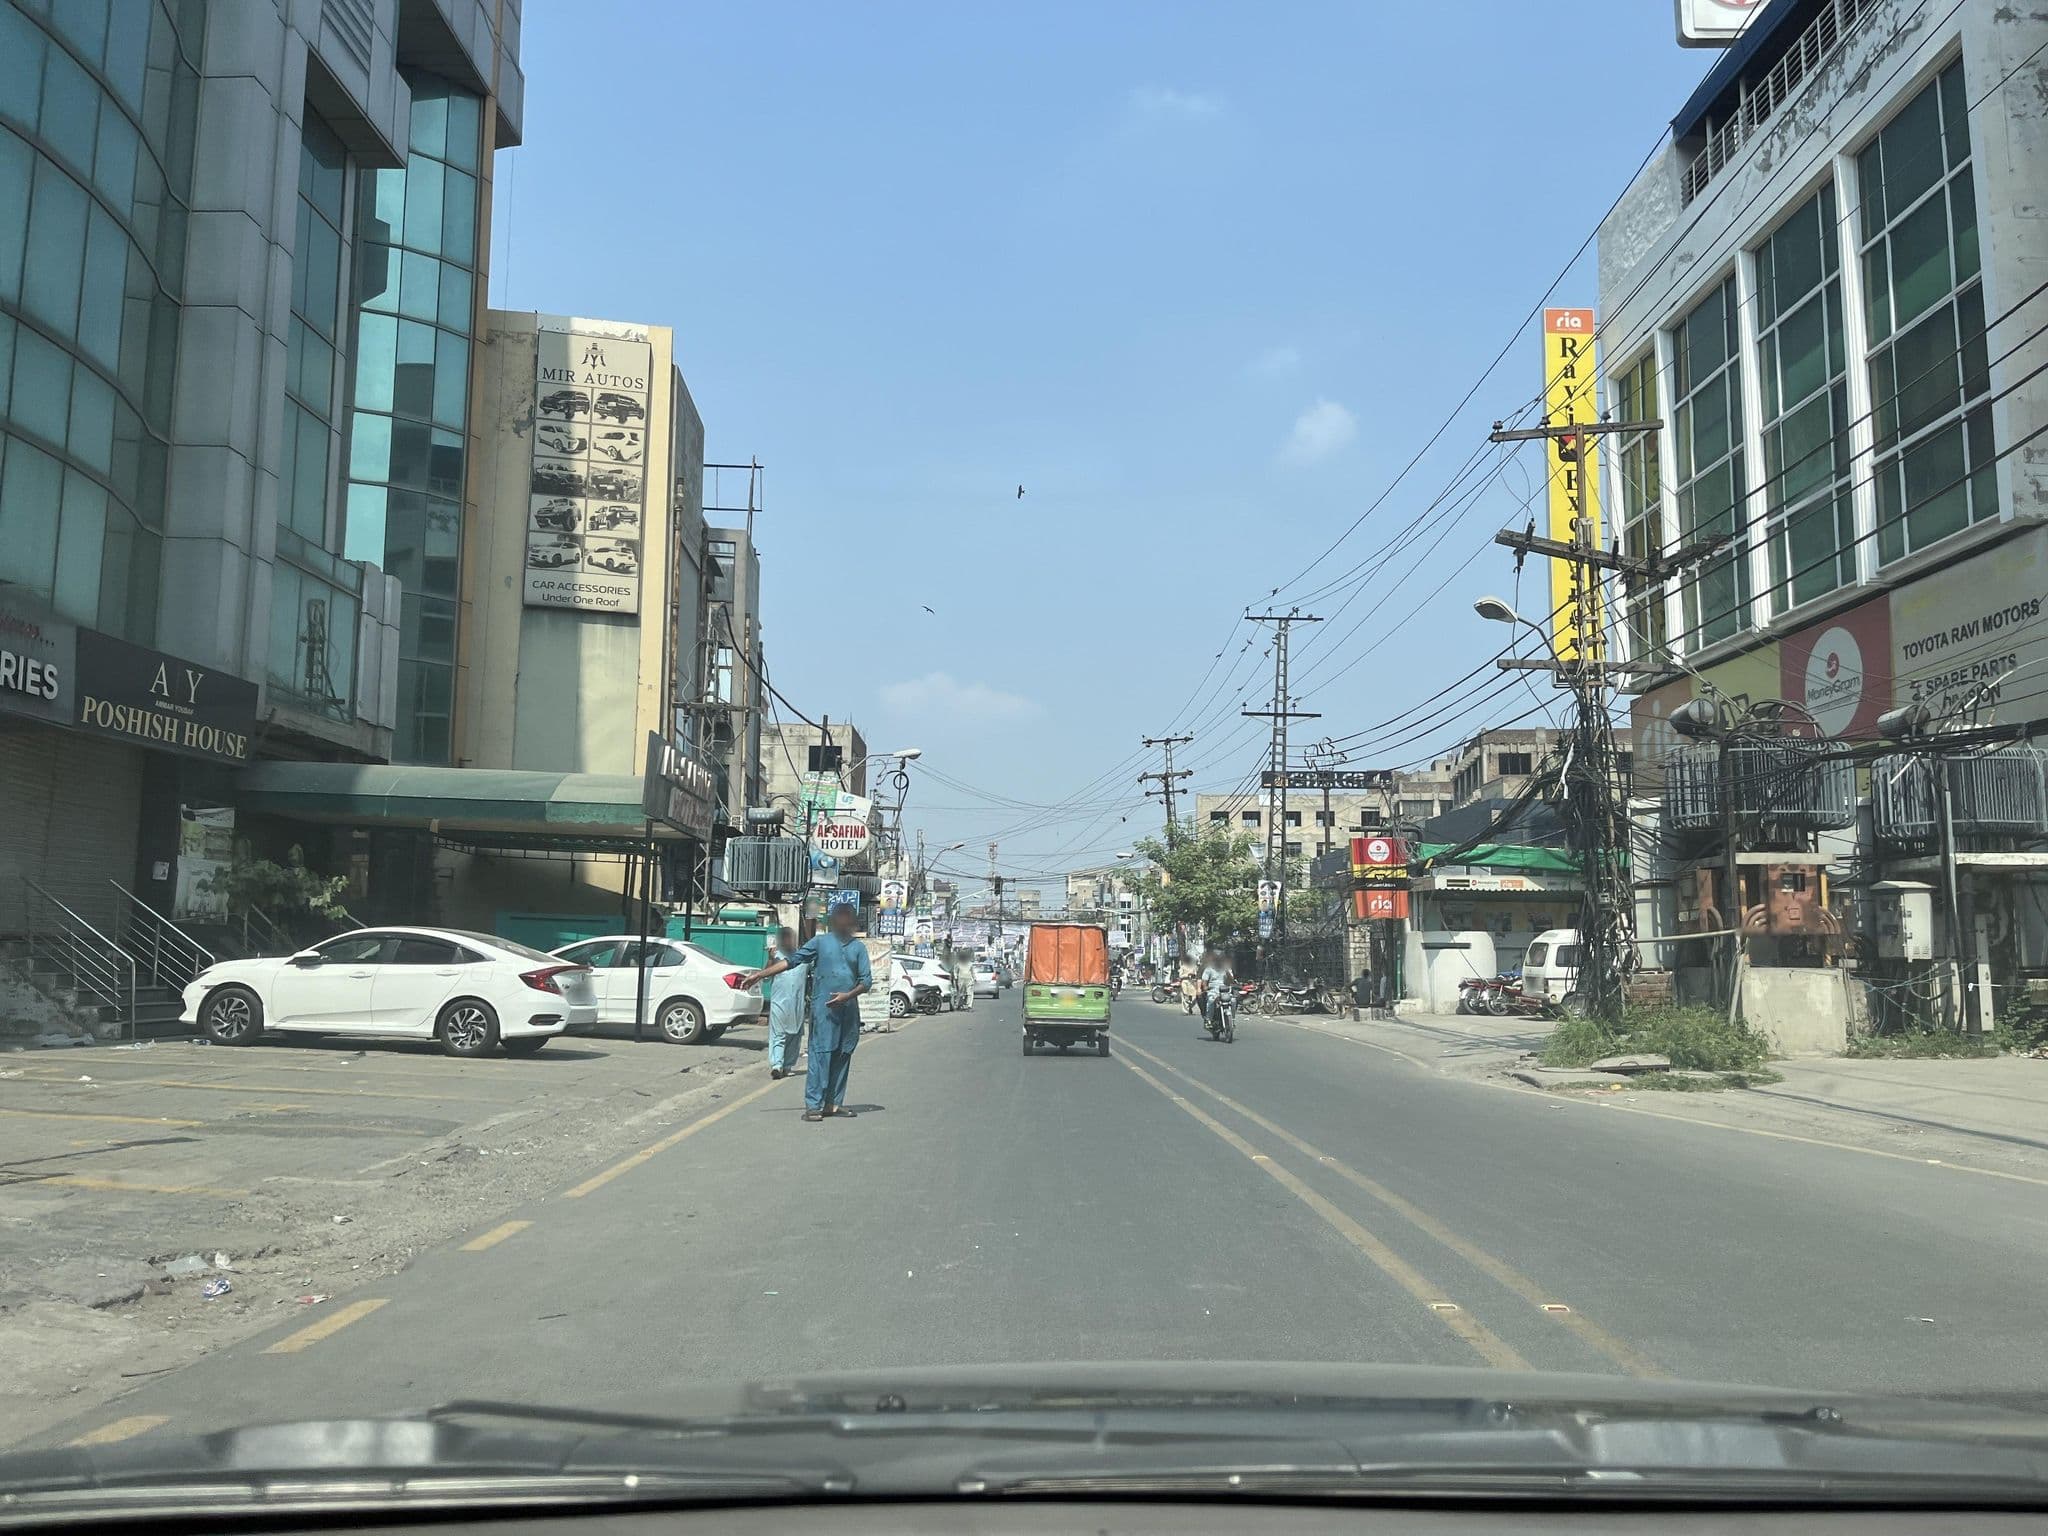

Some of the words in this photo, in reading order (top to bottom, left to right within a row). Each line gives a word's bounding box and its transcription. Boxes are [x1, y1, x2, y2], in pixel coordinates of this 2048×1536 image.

[1556, 312, 1582, 328] ria
[543, 368, 575, 383] MIR
[584, 373, 644, 389] AUTOS
[1560, 337, 1578, 428] Ravi
[532, 580, 555, 589] CAR
[557, 582, 631, 596] ACCESSORIES
[542, 593, 571, 602] Under
[573, 595, 593, 604] One
[596, 597, 620, 606] Roof
[1903, 632, 1949, 660] TOYOTA
[1951, 620, 1979, 644] RAVI
[1982, 598, 2040, 634] MOTORS
[0, 650, 59, 700] RIES
[1926, 669, 1968, 695] SPARE
[1972, 653, 2017, 680] PARTS
[1807, 676, 1860, 701] MoneyGram
[81, 696, 179, 743] POSHISH
[183, 721, 247, 759] HOUSE
[821, 840, 861, 850] HOTEL
[1371, 895, 1393, 910] ria
